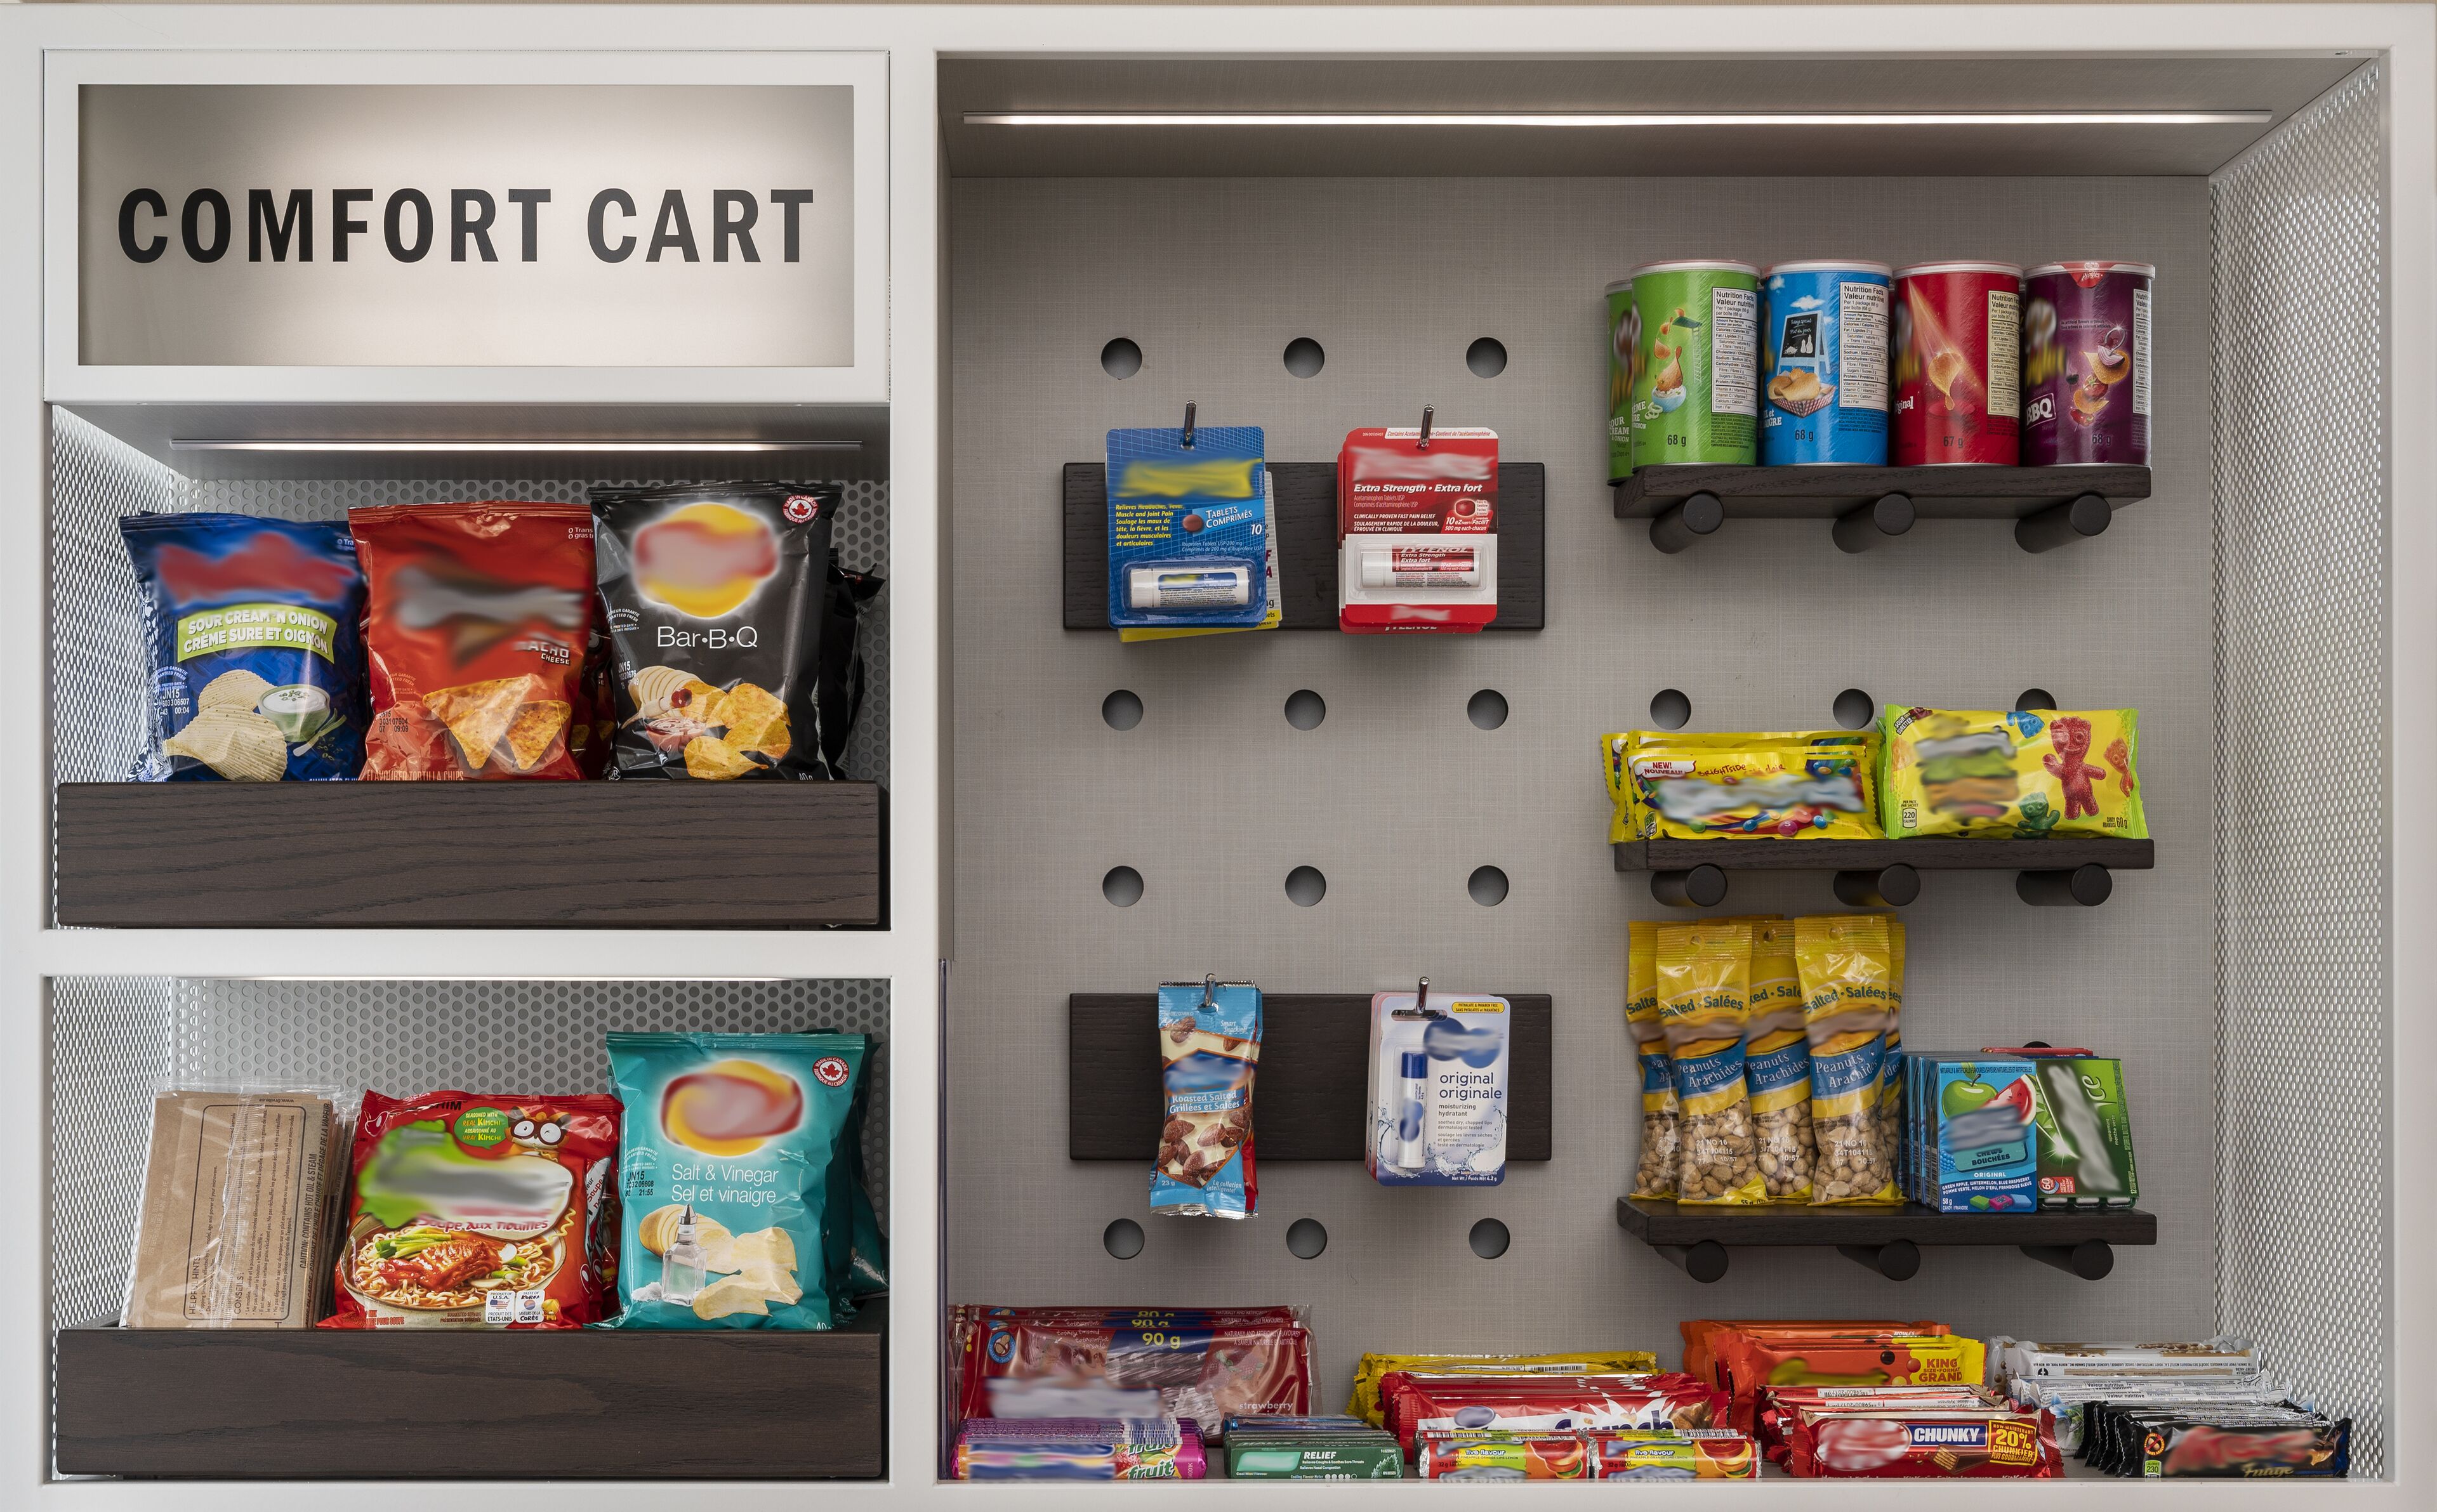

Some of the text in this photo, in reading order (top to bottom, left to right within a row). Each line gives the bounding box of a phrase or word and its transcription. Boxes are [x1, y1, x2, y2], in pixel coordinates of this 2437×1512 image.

[118, 188, 814, 263] COMFORT CART
[1743, 293, 1754, 301] Facts
[1866, 294, 1884, 303] nutritive
[1873, 287, 1884, 296] Facts
[1991, 294, 2013, 303] Nutrition
[2026, 398, 2052, 426] BBQ
[1609, 416, 1625, 428] SOUR
[1667, 434, 1686, 447] 68 g
[1794, 429, 1814, 442] 68 g
[1943, 436, 1964, 448] 67 g
[2092, 434, 2111, 446] 68 g
[1354, 484, 1483, 493] Extra Strength Extra fort
[1206, 506, 1238, 519] TABLETS
[1206, 509, 1253, 529] COMPRIMÉS
[1251, 523, 1262, 536] 10
[188, 611, 328, 636] SOUR CREAM ONION
[183, 627, 328, 654] CRÈME SURE ET OIGNON
[541, 653, 570, 665] CHEESE
[175, 707, 189, 715] 00:04
[1895, 716, 1905, 728] SOUR
[1659, 995, 1744, 1018] Salted Salées
[1804, 986, 1887, 1013] Salted Salées
[1677, 1056, 1722, 1075] Peanuts
[1746, 1053, 1790, 1072] Peanuts
[1816, 1053, 1865, 1074] Peanuts
[1689, 1060, 1743, 1088] Arachides
[1755, 1056, 1810, 1086] Arachides
[1828, 1060, 1879, 1089] Arachides
[1439, 1072, 1494, 1086] original
[1172, 1090, 1237, 1103] Roasted Salted
[1439, 1087, 1502, 1101] originale
[1170, 1103, 1203, 1114] Grillées
[1213, 1100, 1240, 1110] Salées
[321, 1103, 331, 1127] VAPEUR
[477, 1118, 501, 1126] KIMCHI
[1971, 1154, 2011, 1166] BOUCHÉES
[671, 1164, 779, 1187] Salt & Vinegar
[2008, 1176, 2030, 1185] RASPBERRY
[1219, 1181, 1242, 1189] collation
[671, 1184, 776, 1207] Sel et vinaigre
[300, 1154, 317, 1269] CAUTION: CONTAINS HOT OIL STEAM
[192, 1254, 201, 1280] HINTS:
[1142, 1333, 1181, 1350] 90 g
[1927, 1359, 1958, 1369] KING
[1919, 1372, 1962, 1383] GRAND
[1239, 1402, 1293, 1415] strawberry
[1914, 1428, 1980, 1442] CHUNKY
[1995, 1429, 2031, 1449] 20%
[1304, 1451, 1337, 1459] RELIEF
[1128, 1461, 1175, 1479] fruit
